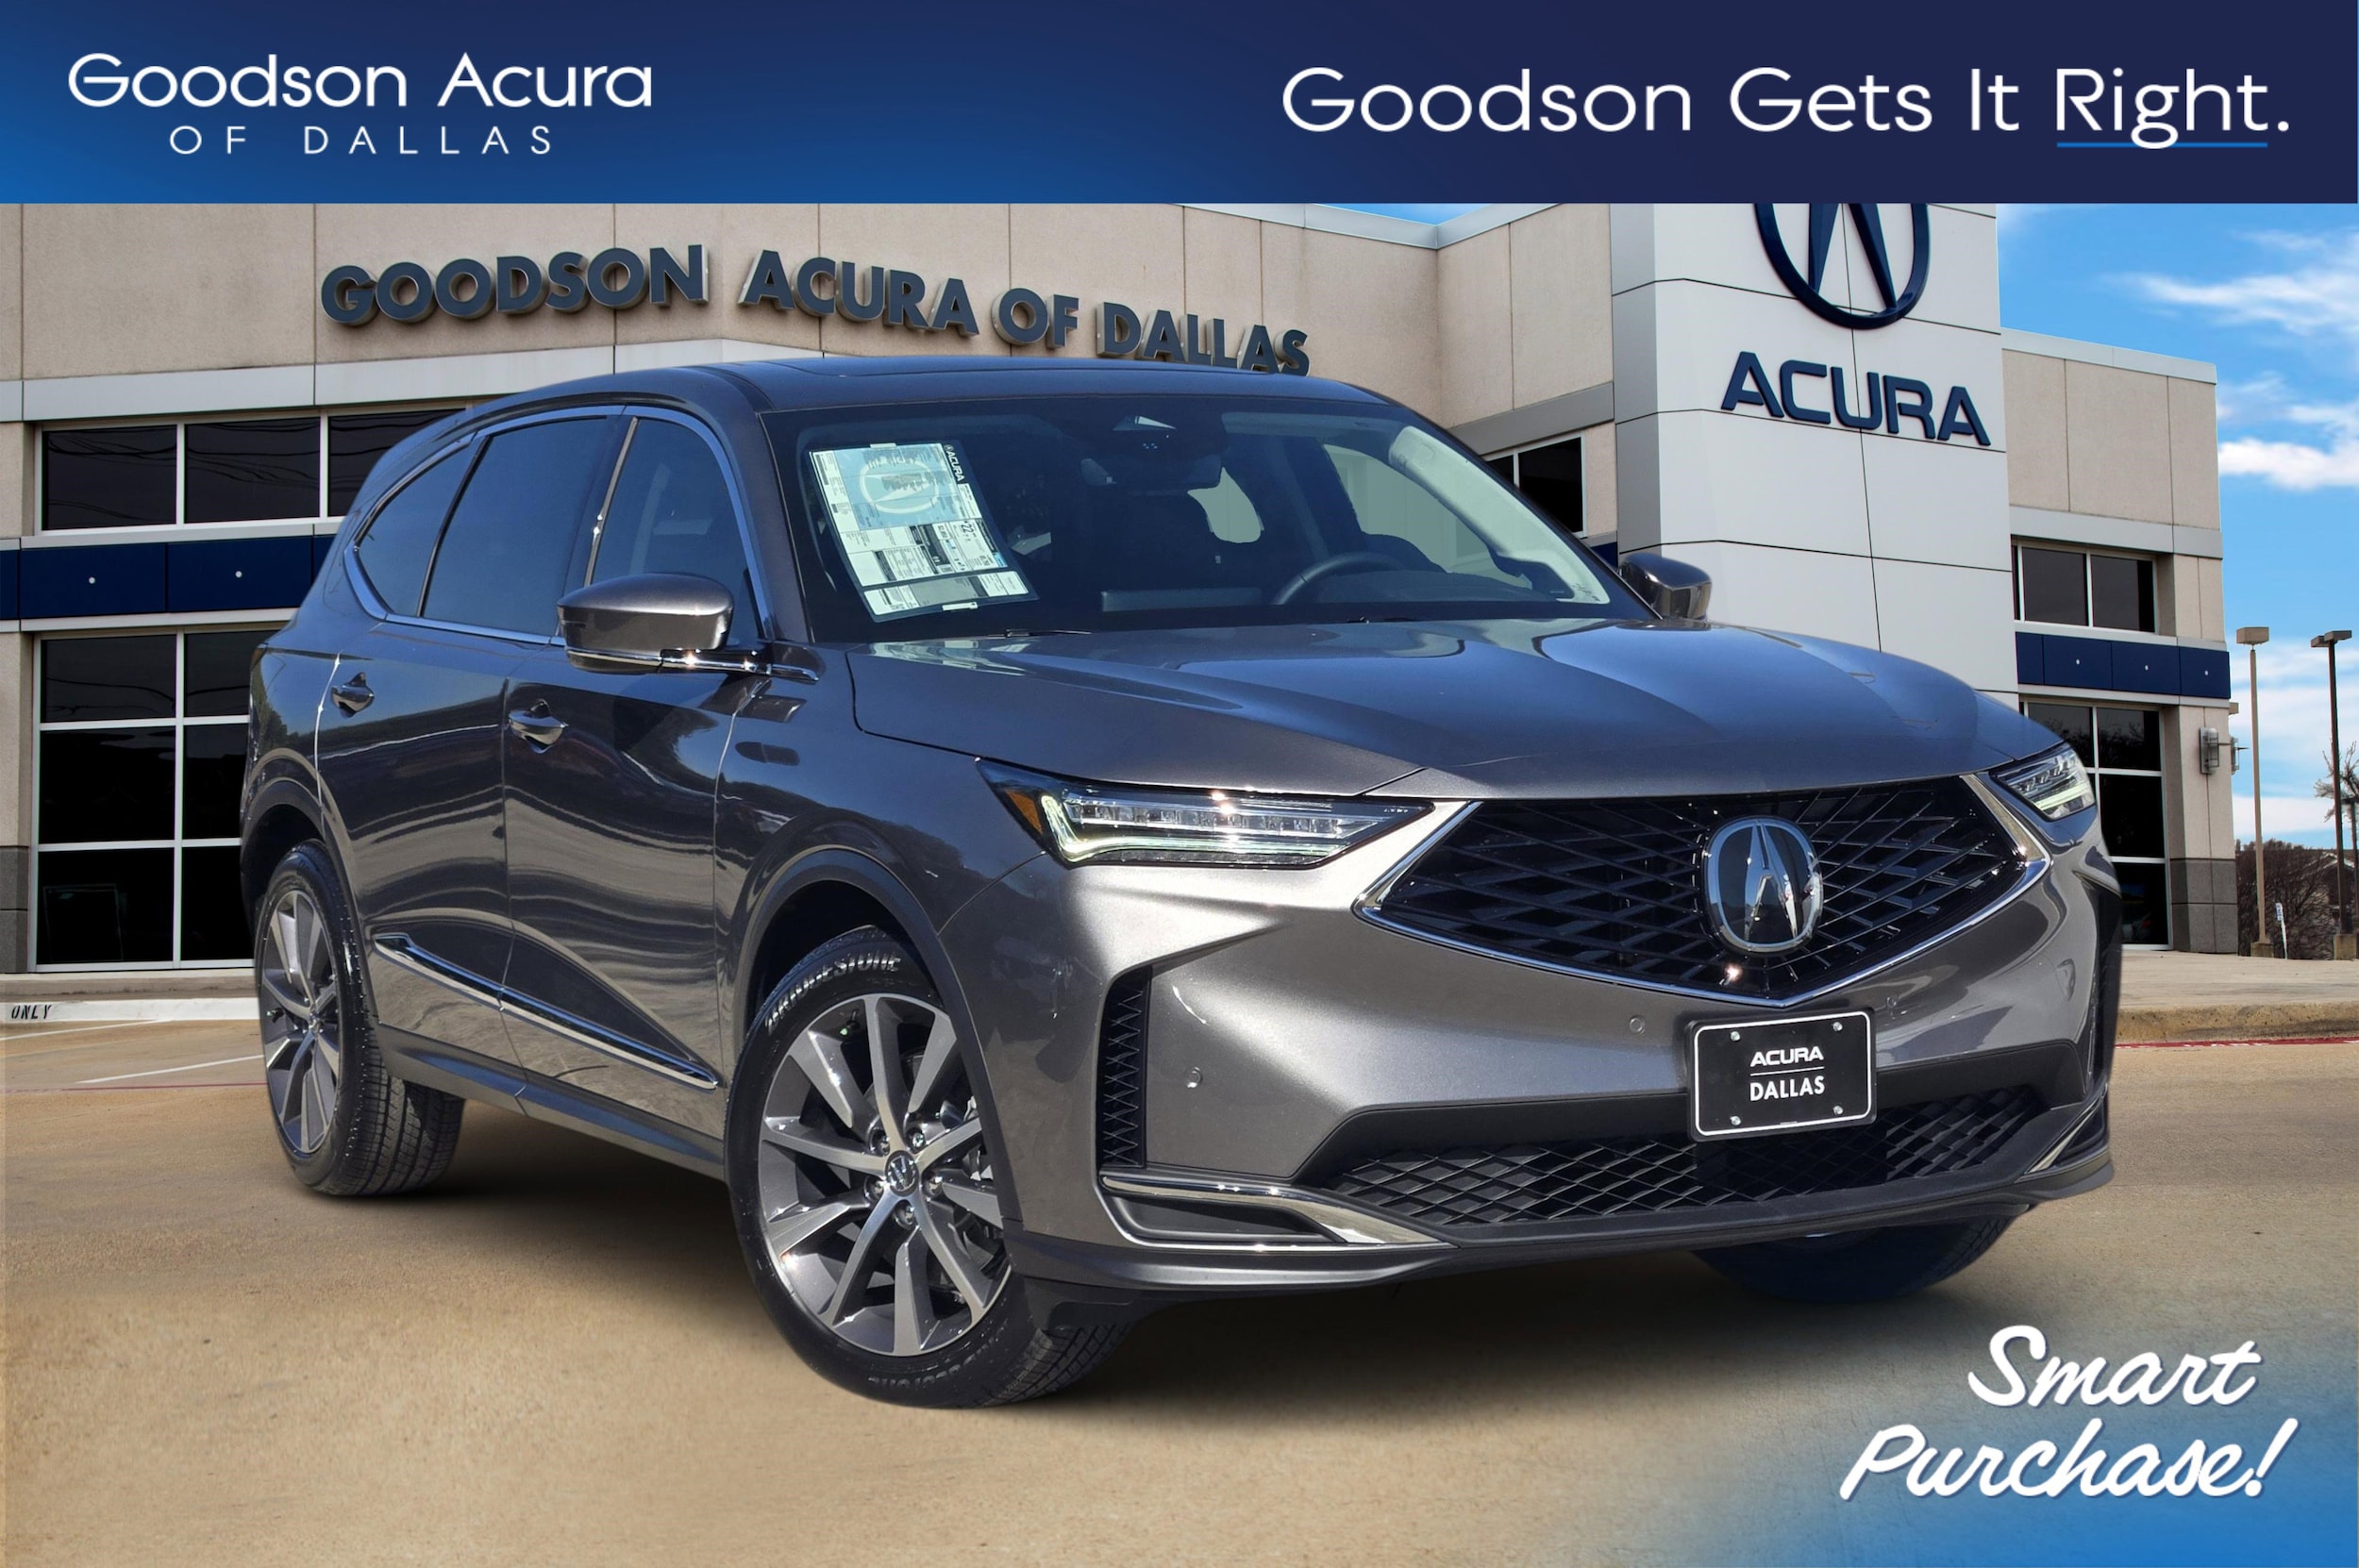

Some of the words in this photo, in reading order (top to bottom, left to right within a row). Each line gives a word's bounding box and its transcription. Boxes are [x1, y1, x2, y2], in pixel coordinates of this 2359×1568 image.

[321, 243, 708, 327] GOODSON
[739, 249, 979, 337] ACURA
[992, 288, 1079, 349] OF
[1096, 301, 1311, 377] DALLAS
[1720, 351, 1991, 446] ACURA
[946, 451, 964, 481] ACURA
[11, 1005, 52, 1019] ONLY
[1750, 1046, 1824, 1067] ACURA
[1749, 1076, 1825, 1101] DALLAS
